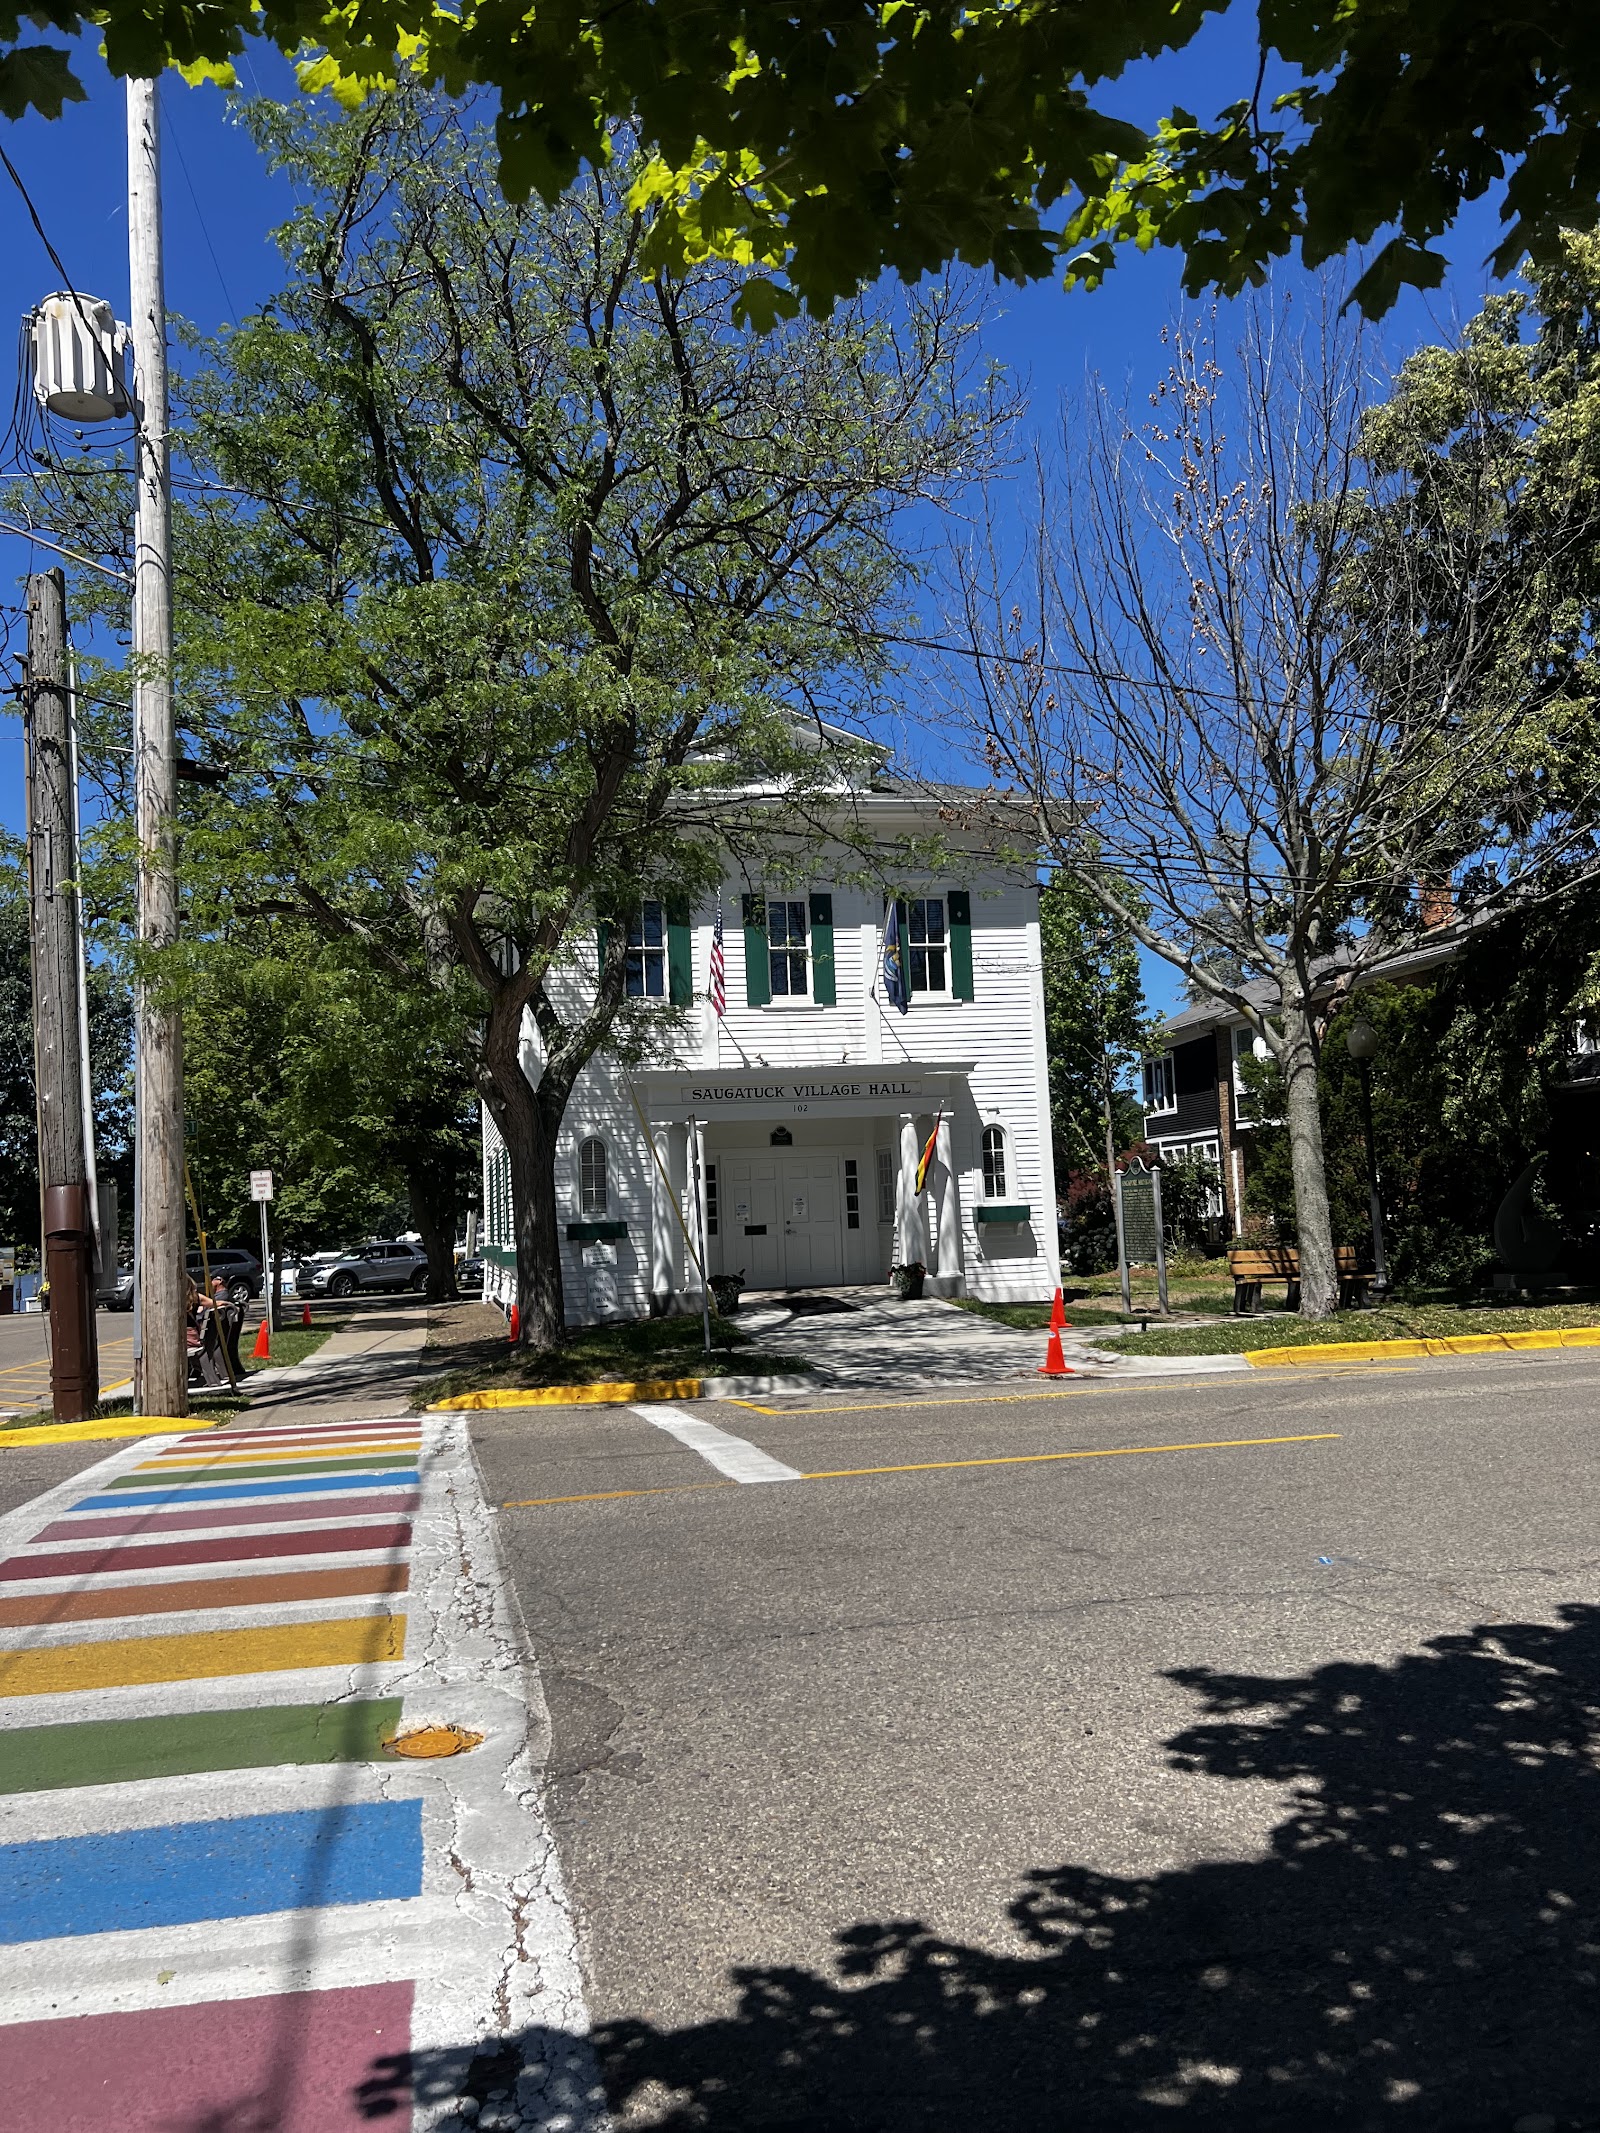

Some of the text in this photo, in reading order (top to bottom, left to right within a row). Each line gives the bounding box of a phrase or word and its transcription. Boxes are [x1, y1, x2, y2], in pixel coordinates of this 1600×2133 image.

[692, 1083, 911, 1100] SAUGATUCK VILLAGE HALL
[793, 1104, 808, 1113] 102
